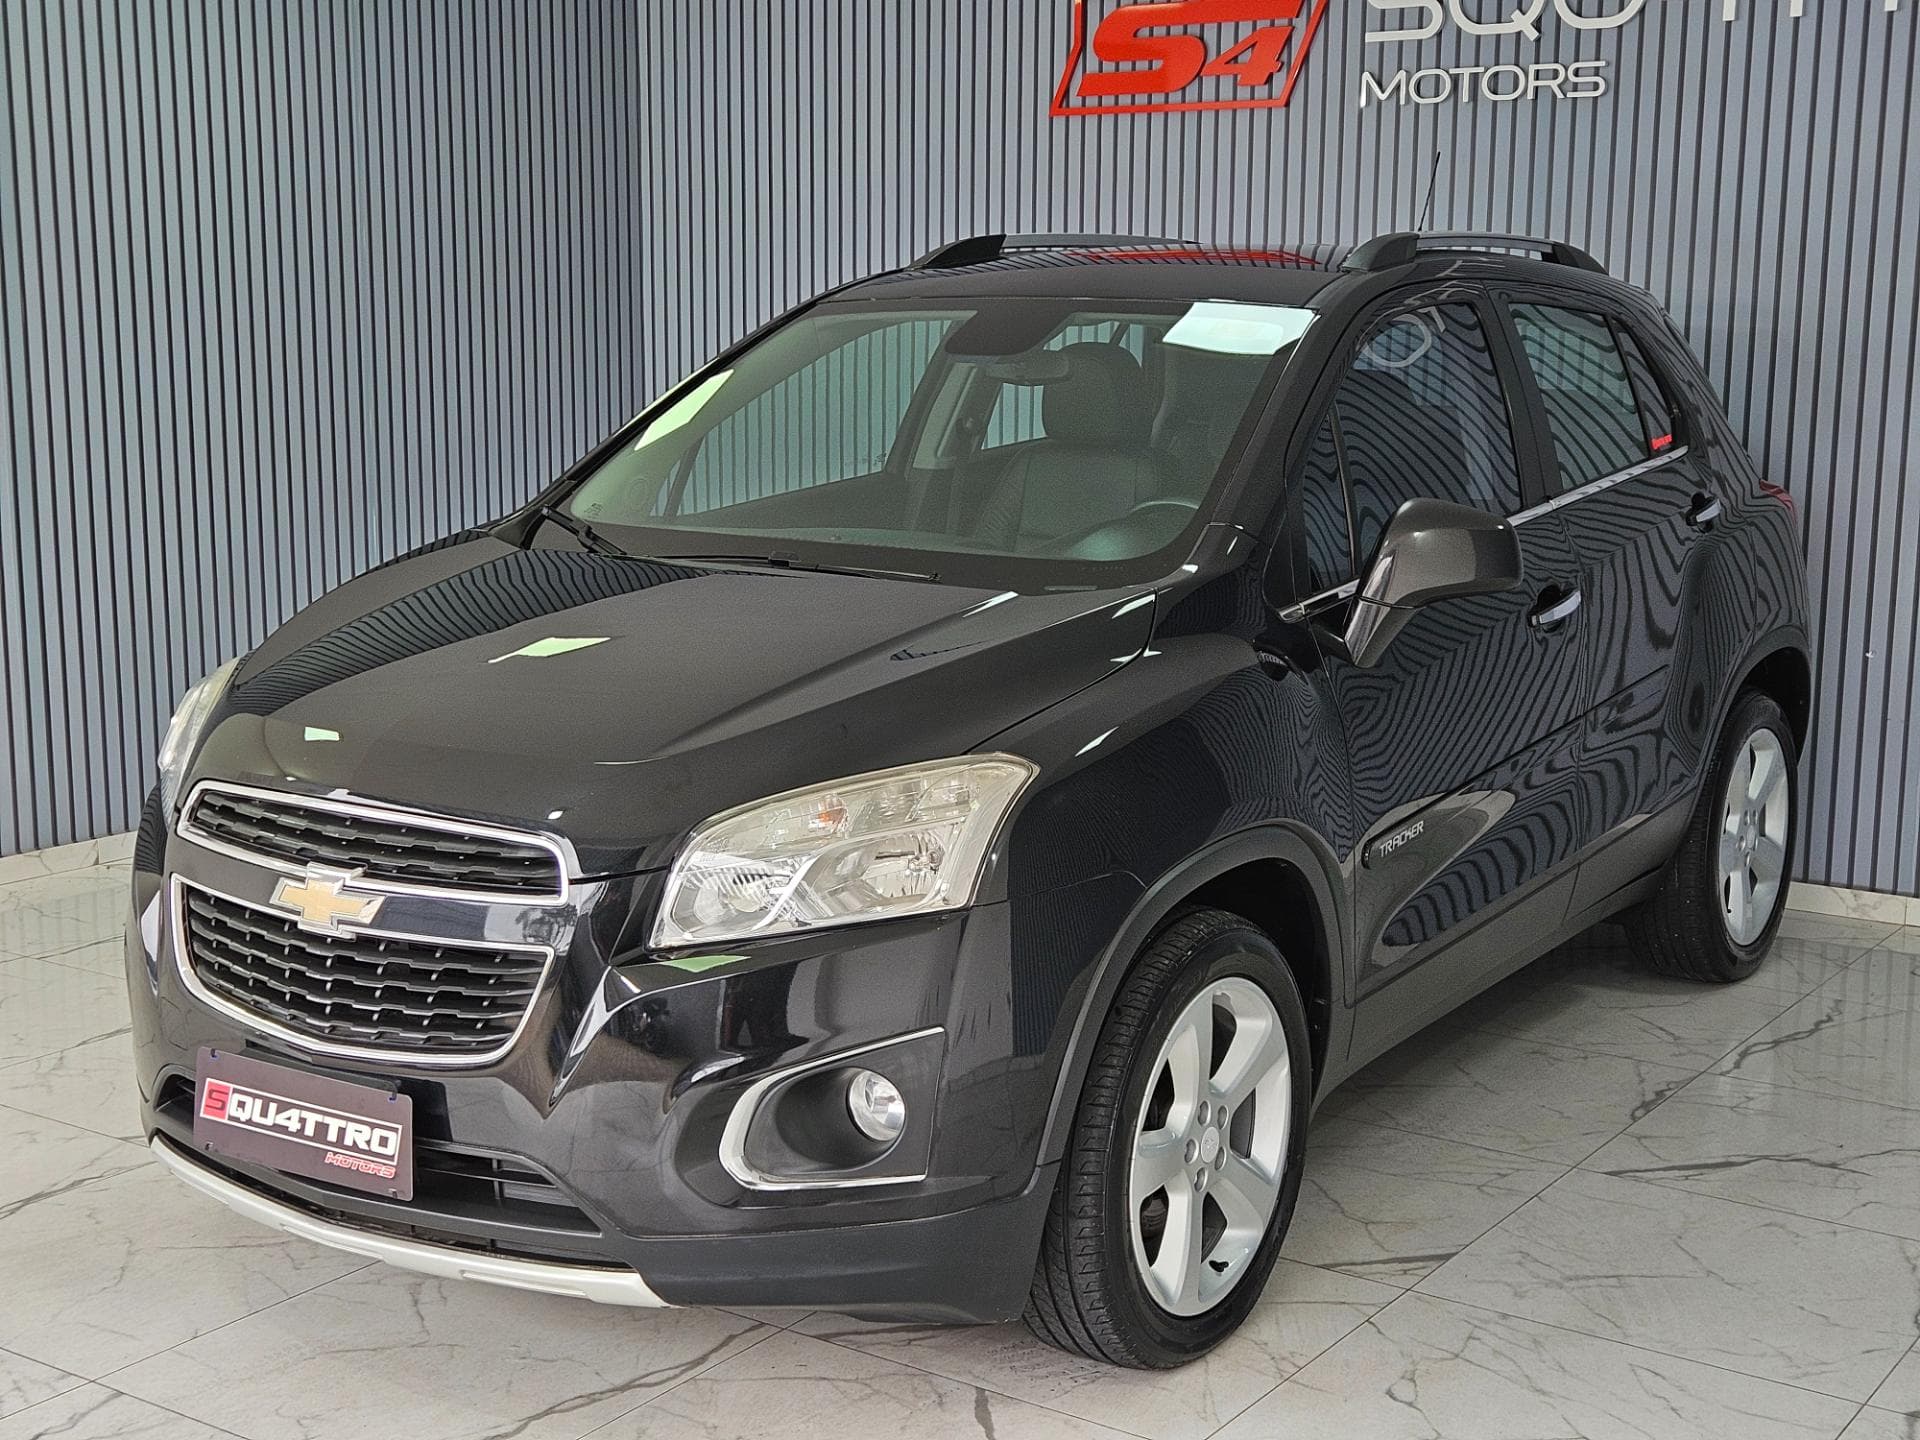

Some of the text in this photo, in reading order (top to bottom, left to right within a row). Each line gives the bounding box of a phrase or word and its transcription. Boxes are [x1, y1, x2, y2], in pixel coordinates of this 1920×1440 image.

[1077, 0, 1302, 97] S4
[1360, 60, 1607, 108] MOTORS
[1379, 820, 1424, 857] TRACKER
[204, 1086, 399, 1155] SQU4TTRO
[324, 1152, 397, 1179] MOTORS
